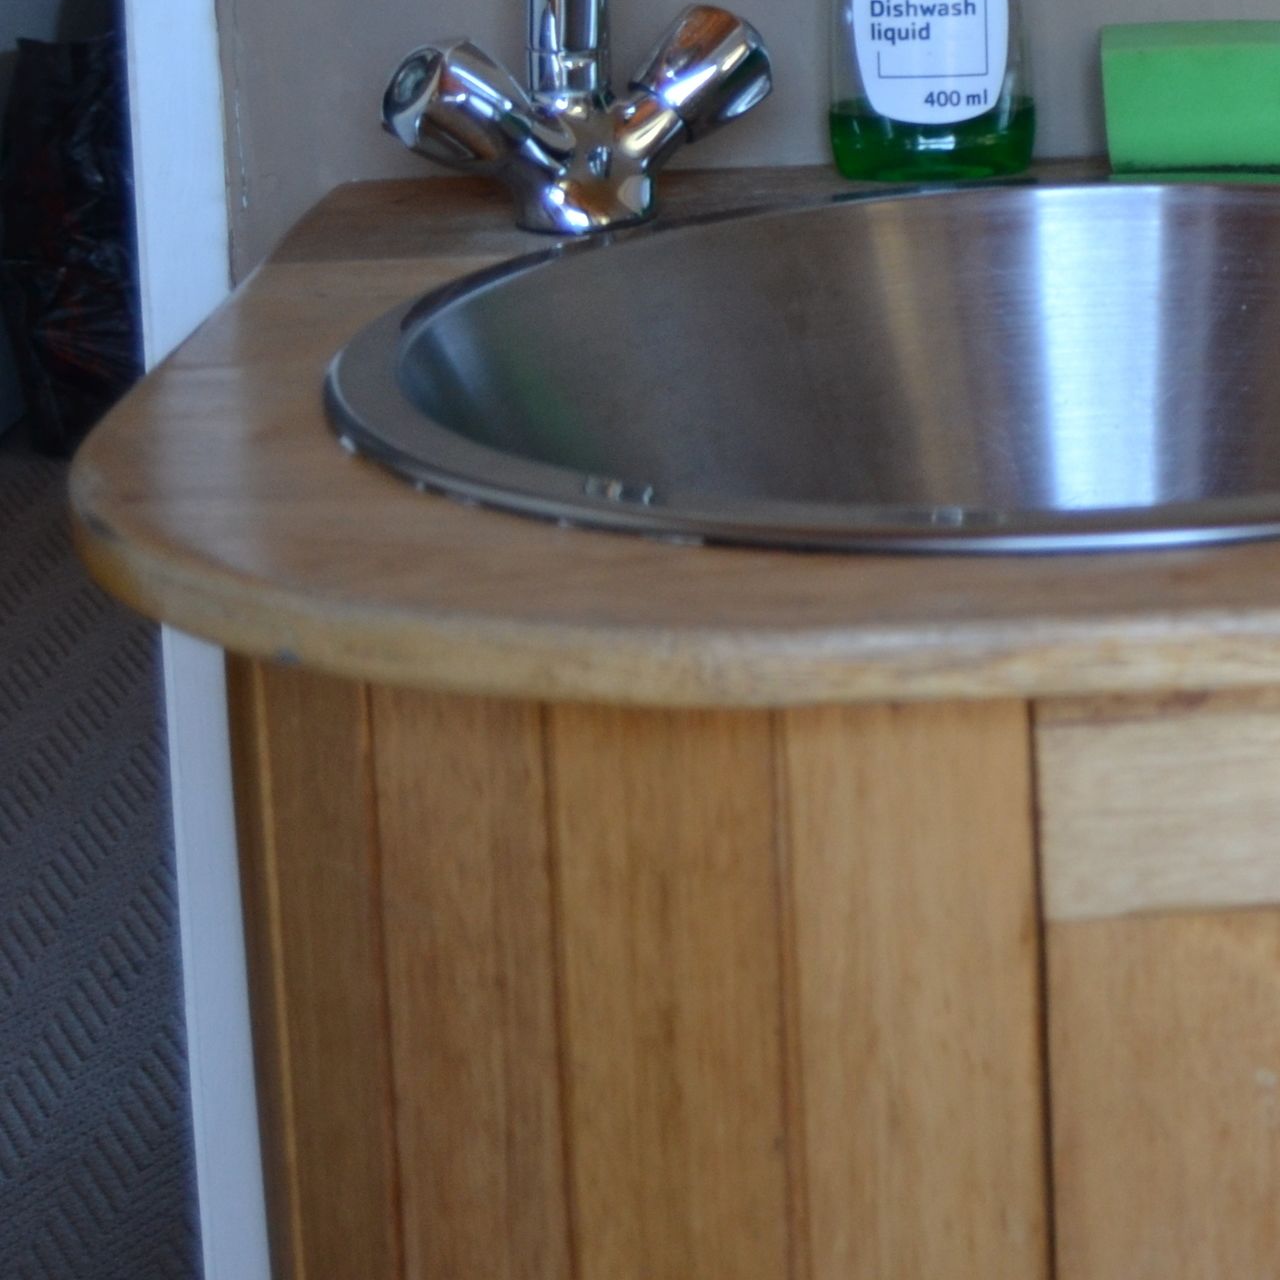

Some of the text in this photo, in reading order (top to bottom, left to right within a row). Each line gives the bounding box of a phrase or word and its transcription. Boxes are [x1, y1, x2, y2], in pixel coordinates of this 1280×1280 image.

[871, 23, 931, 45] liquid
[924, 88, 988, 107] 400 ml
